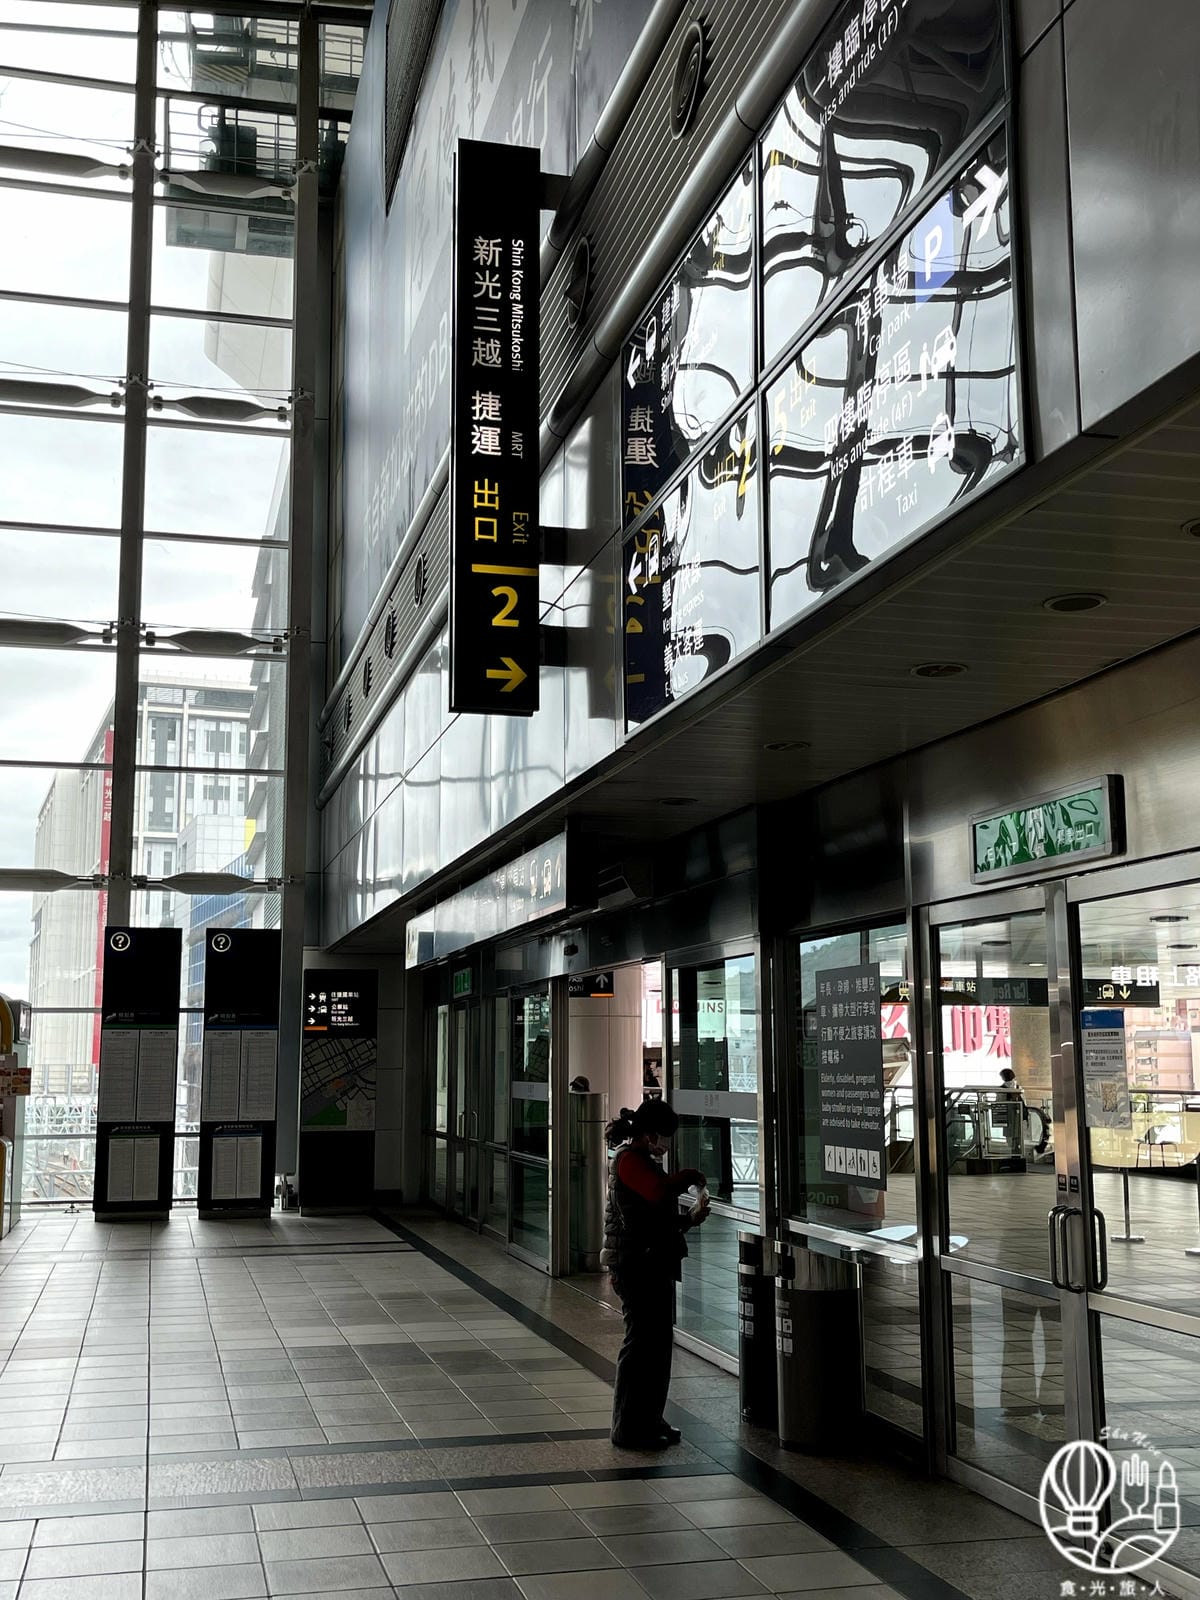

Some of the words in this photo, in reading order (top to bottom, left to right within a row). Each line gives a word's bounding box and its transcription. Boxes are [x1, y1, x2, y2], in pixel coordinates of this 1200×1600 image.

[838, 76, 857, 106] and
[857, 47, 877, 80] ride
[877, 11, 900, 52] (1F)
[510, 238, 525, 267] Shin
[924, 224, 943, 282] P
[471, 234, 504, 369] 新光三越
[509, 268, 525, 301] Kong
[855, 253, 910, 354] 停車場
[510, 302, 524, 372] Mitsukoshi
[886, 308, 912, 345] park
[470, 390, 503, 458] 捷運
[511, 430, 524, 460] MRT
[773, 389, 787, 456] 5
[799, 404, 817, 429] Exit
[829, 452, 850, 481] kiss
[890, 389, 914, 432] (4F)
[859, 433, 916, 513] 計程車
[473, 477, 500, 544] 出口
[511, 510, 530, 545] Exit
[895, 488, 918, 519] Taxi
[490, 584, 521, 629] 2
[986, 841, 1018, 862] EXIT
